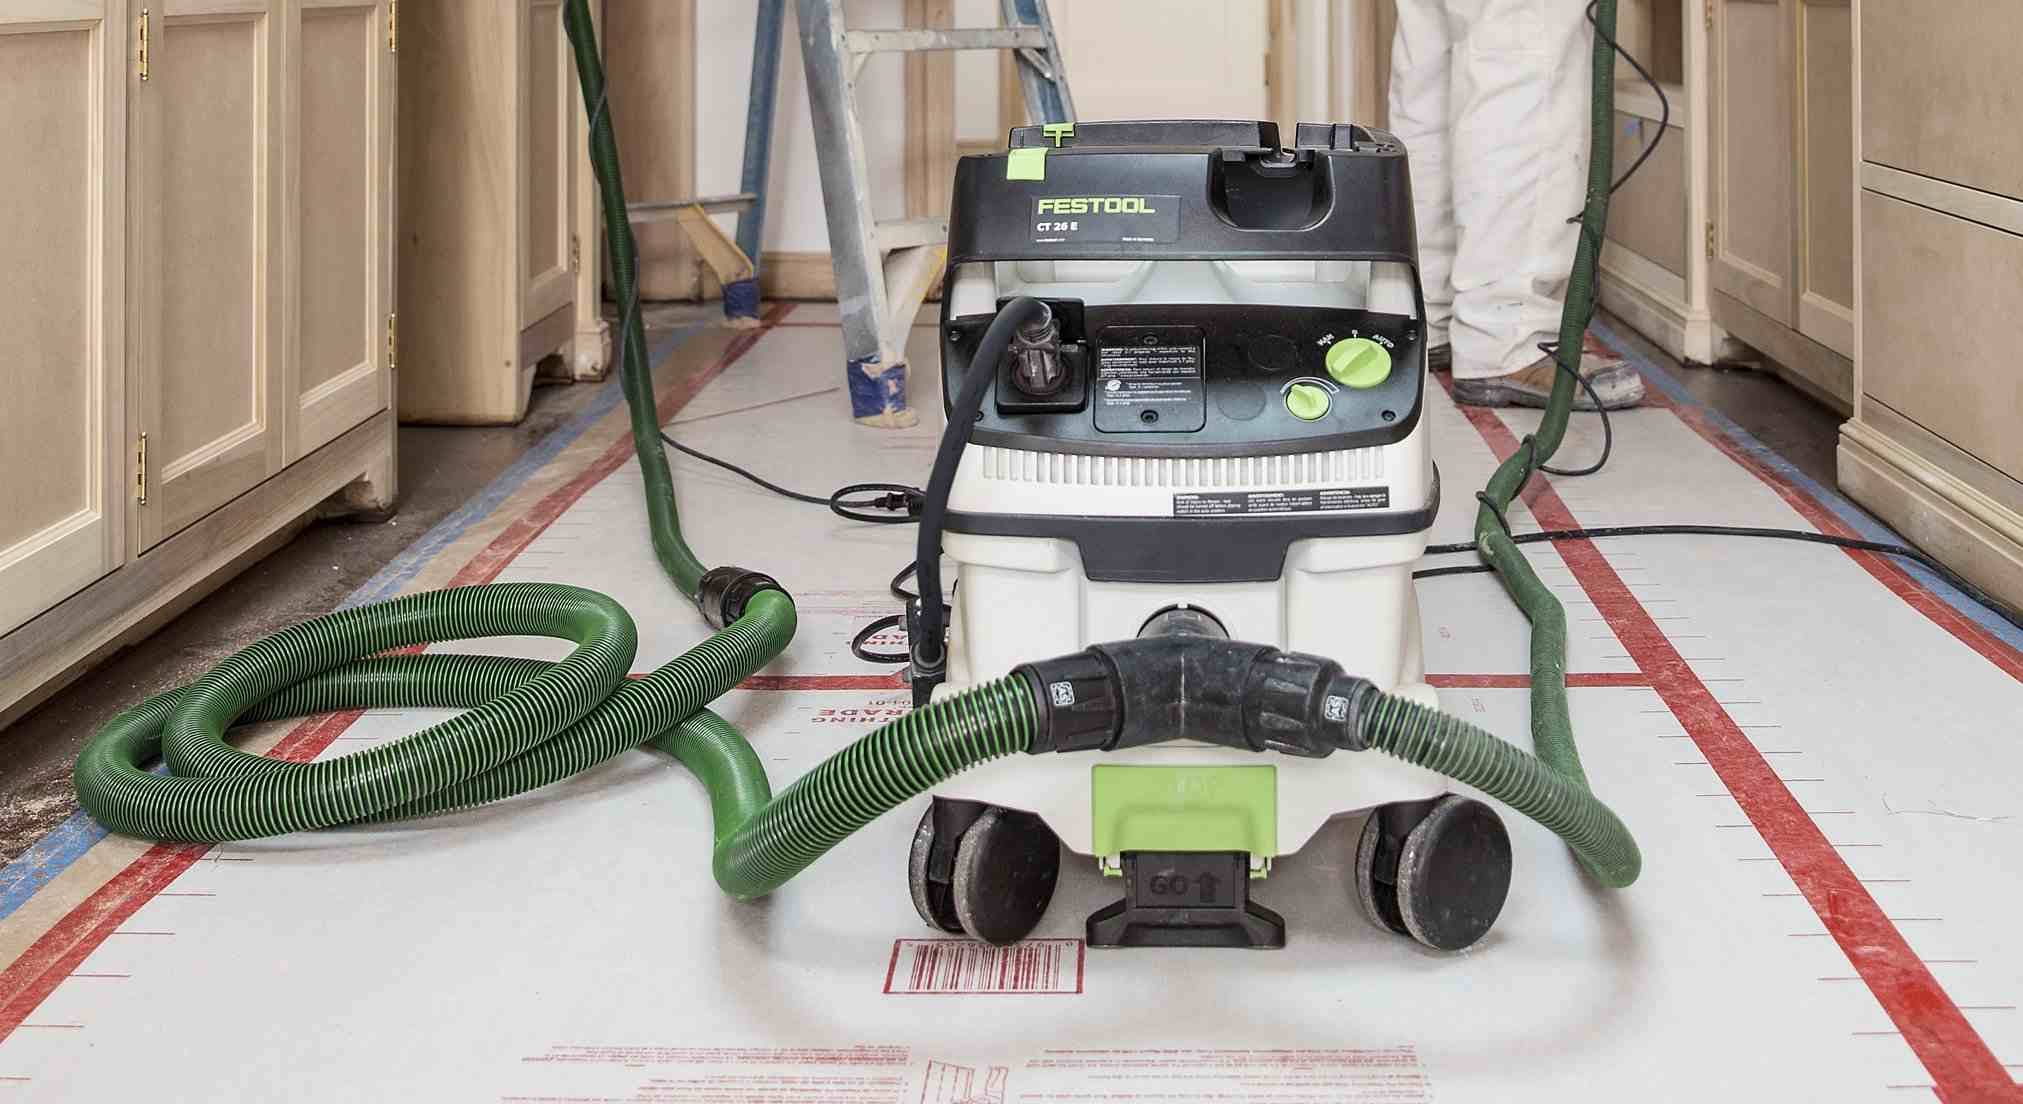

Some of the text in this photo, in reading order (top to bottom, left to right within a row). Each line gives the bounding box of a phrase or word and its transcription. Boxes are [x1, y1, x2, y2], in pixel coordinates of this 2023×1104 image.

[1037, 197, 1156, 214] FESTOOL
[1036, 221, 1078, 232] CT 26 E
[1372, 334, 1395, 349] AUTO
[1150, 875, 1188, 895] GO
